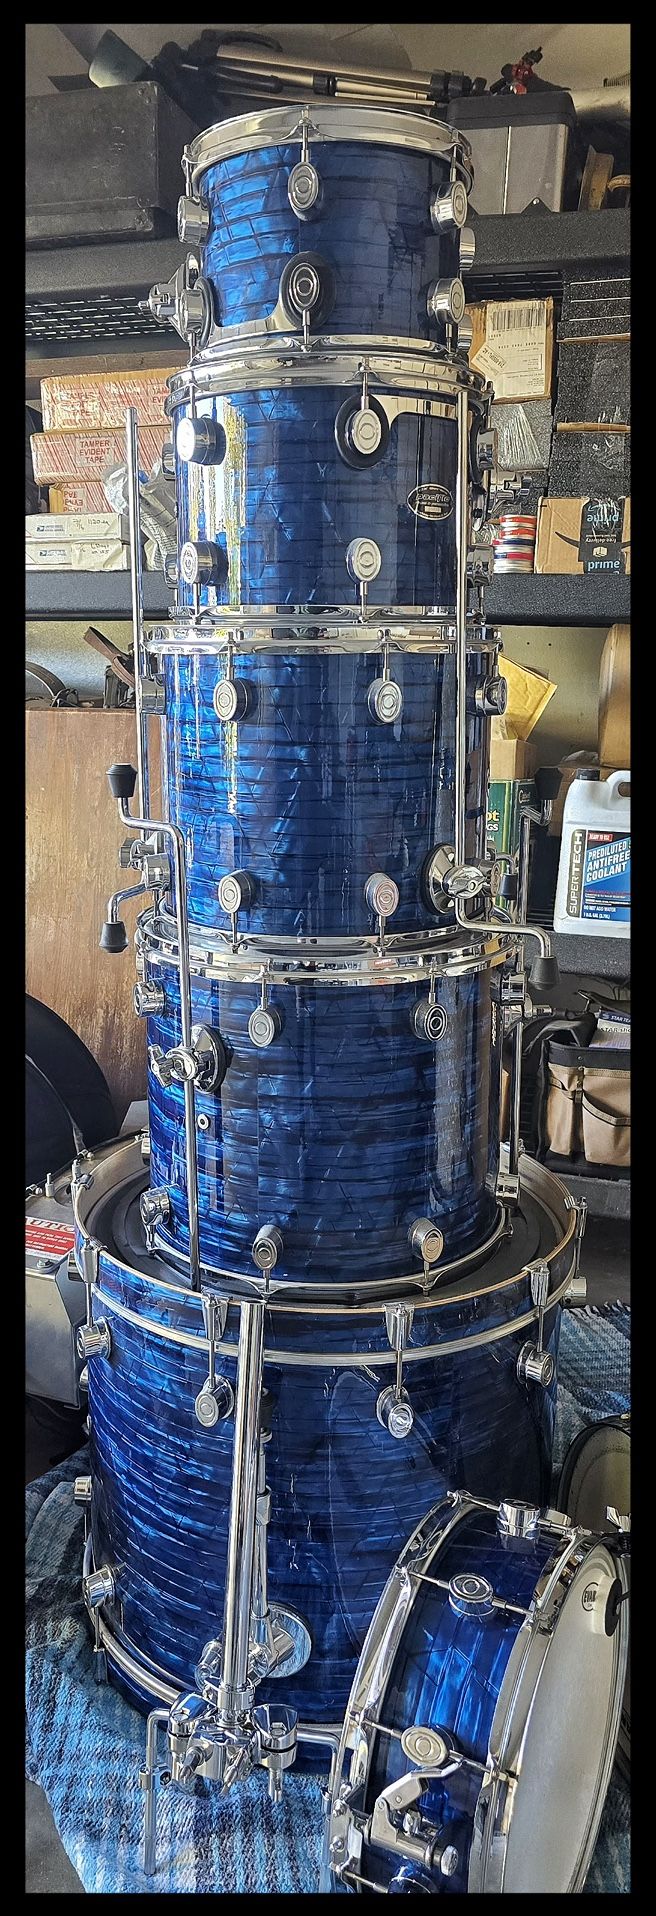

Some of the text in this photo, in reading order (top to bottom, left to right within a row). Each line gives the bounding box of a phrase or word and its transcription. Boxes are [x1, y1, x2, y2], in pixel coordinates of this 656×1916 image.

[79, 440, 110, 448] TAMPER
[79, 448, 110, 456] EVIDENT
[587, 560, 621, 572] prime
[587, 841, 627, 861] PREDILUTED
[586, 862, 628, 882] COOLANT
